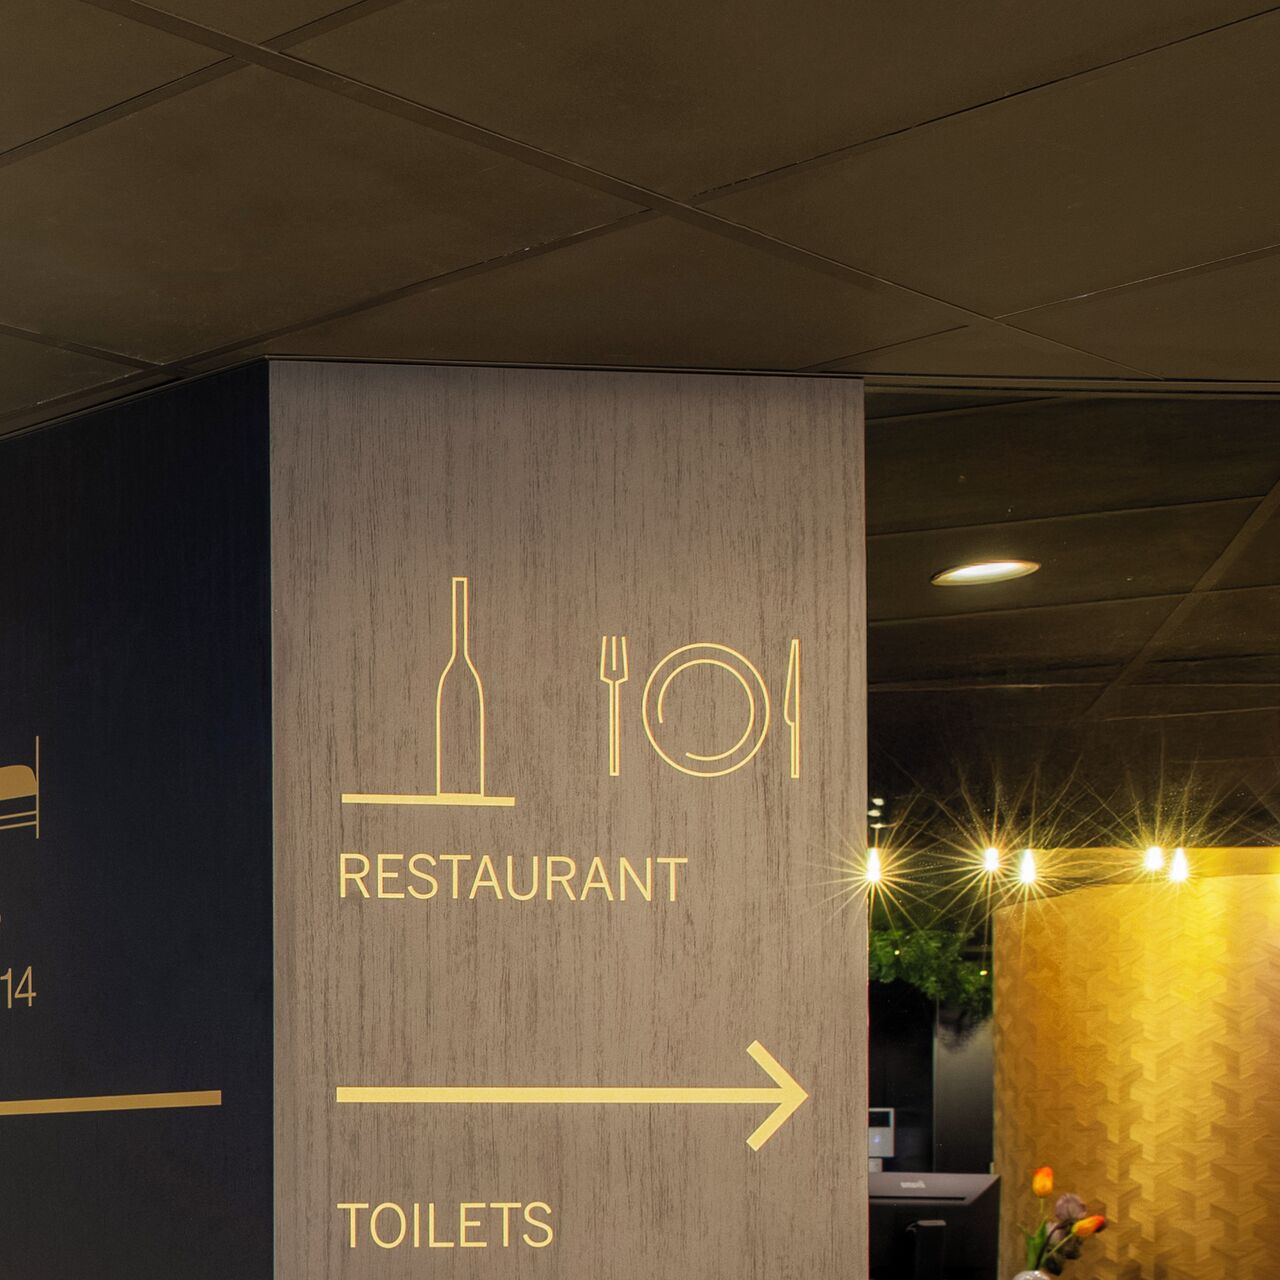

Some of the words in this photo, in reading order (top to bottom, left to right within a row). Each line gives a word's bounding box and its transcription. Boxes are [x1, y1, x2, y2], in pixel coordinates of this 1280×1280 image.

[339, 852, 689, 901] RESTAURANT
[0, 966, 38, 1010] 14
[337, 1201, 554, 1248] TOILETS
